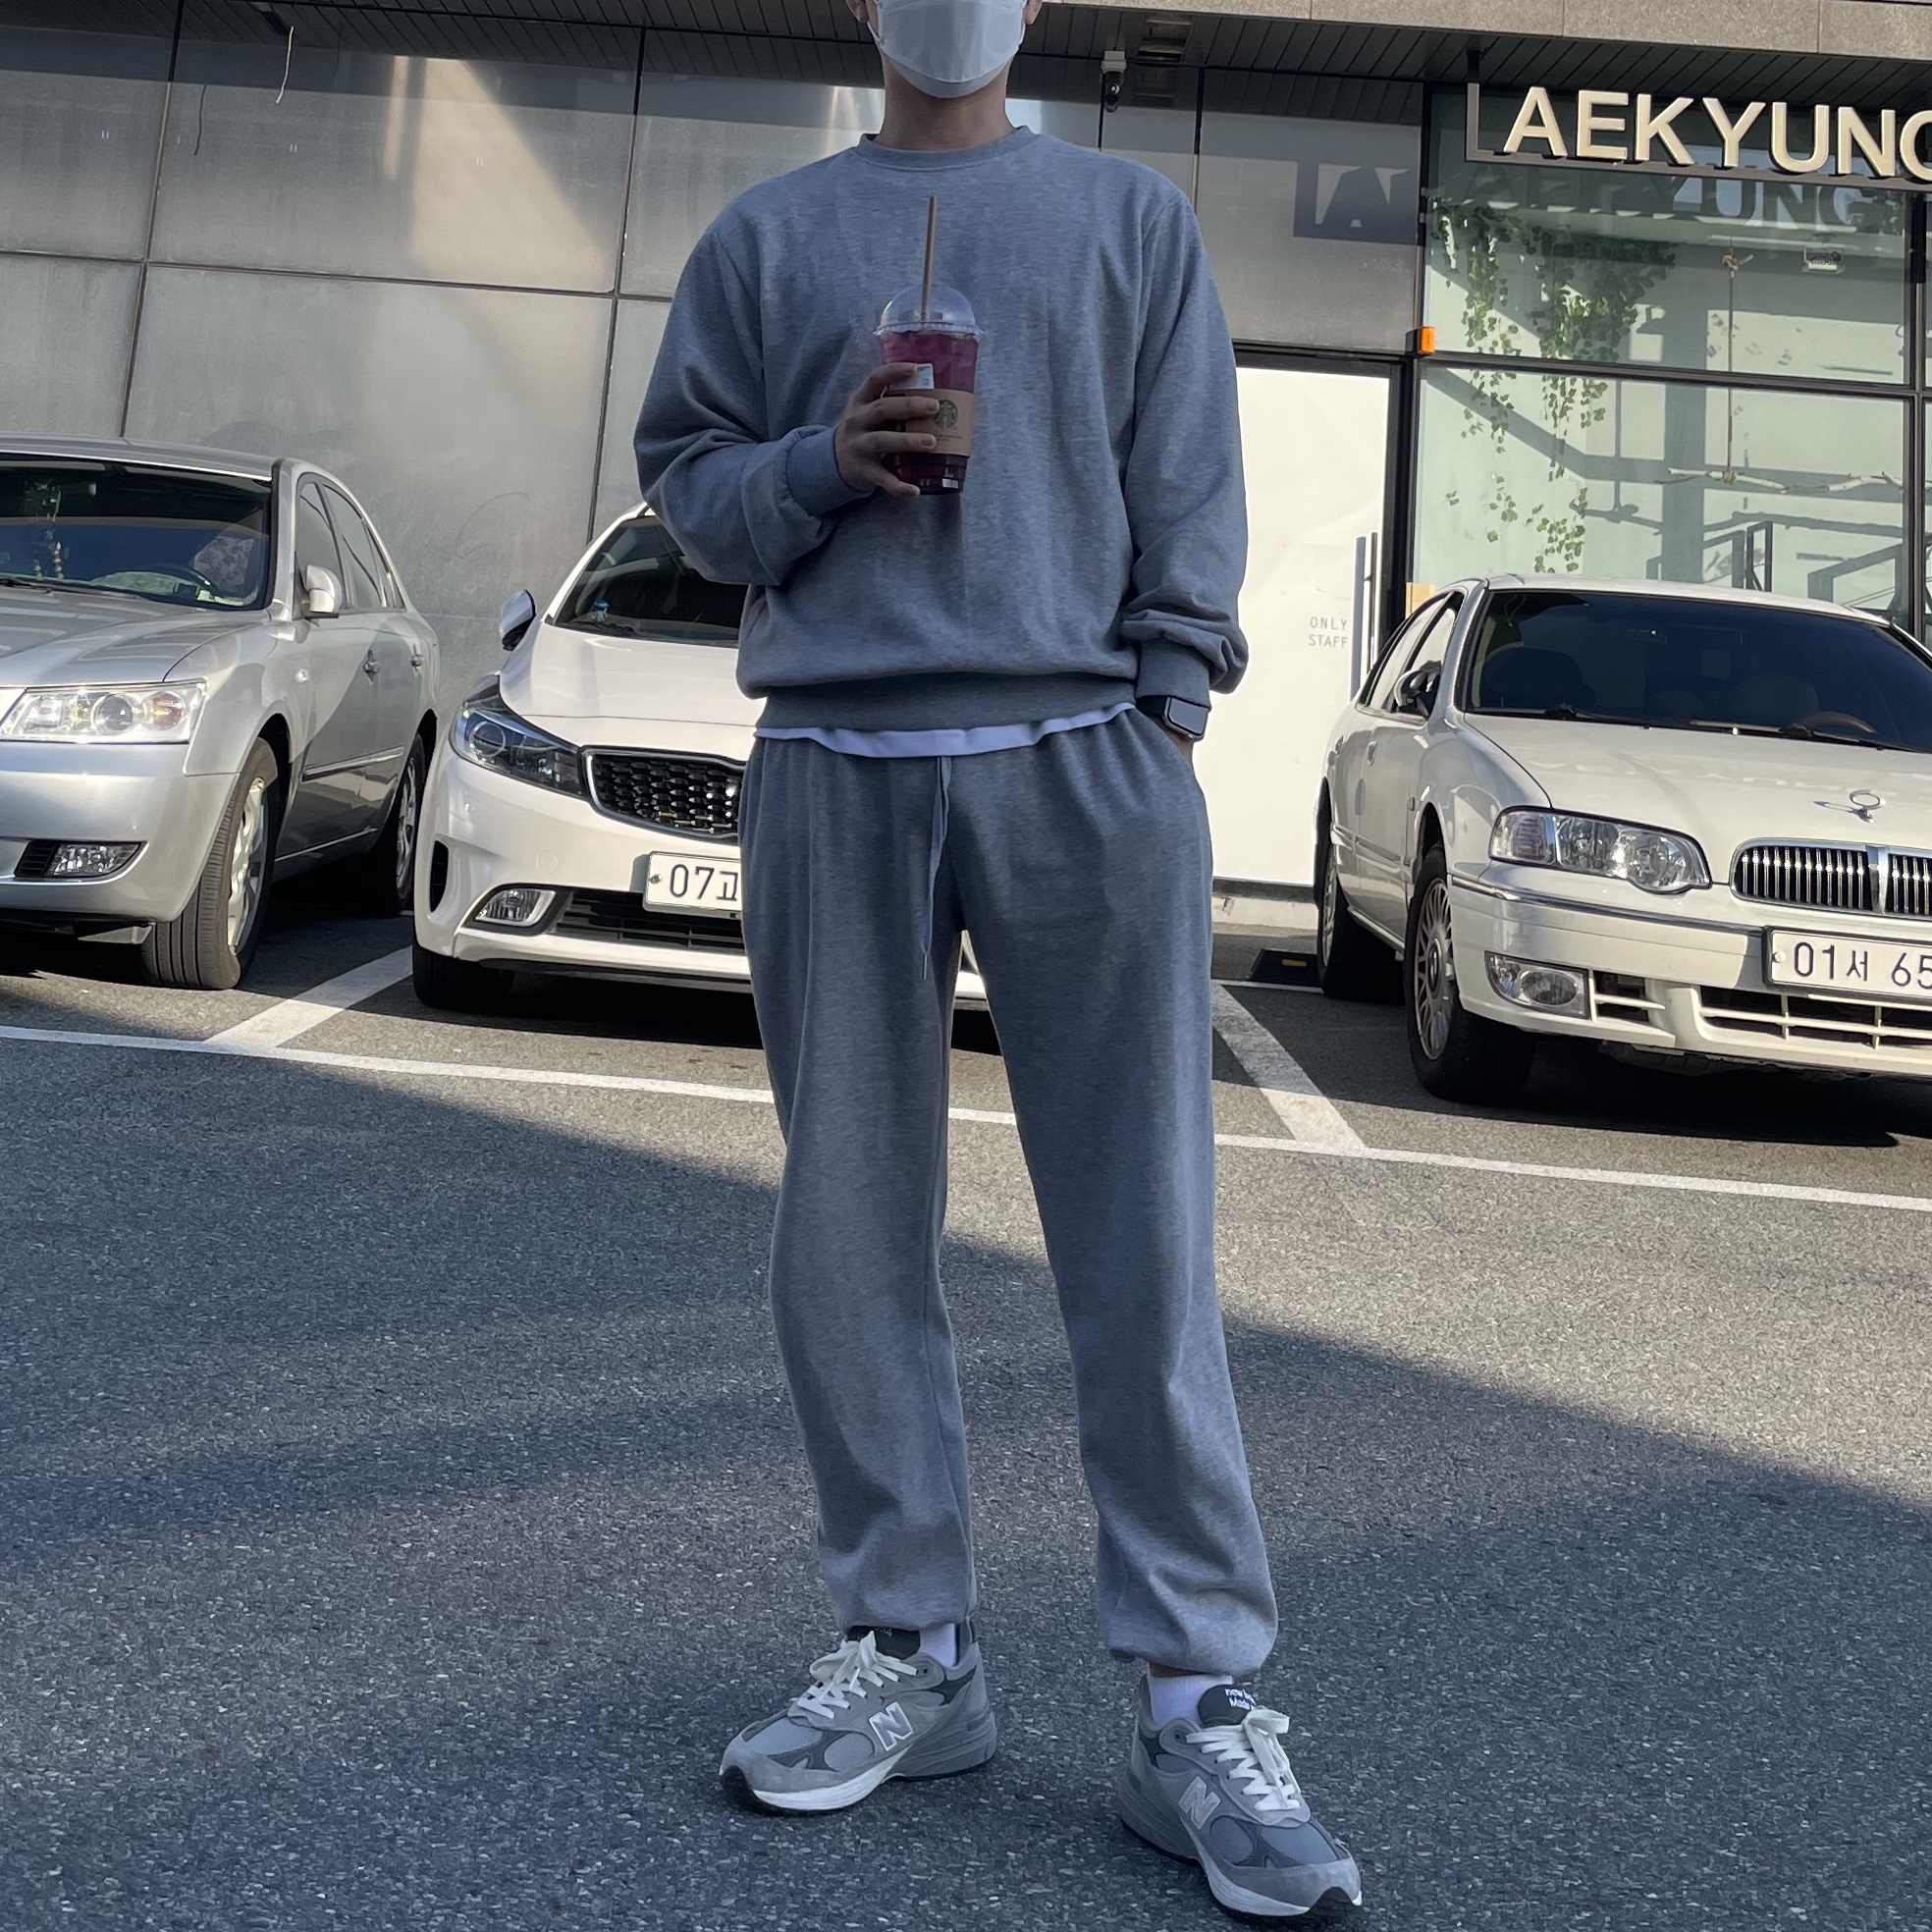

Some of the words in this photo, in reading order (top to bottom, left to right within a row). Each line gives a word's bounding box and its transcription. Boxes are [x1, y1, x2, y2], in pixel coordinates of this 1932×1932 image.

[1308, 633, 1349, 649] STAFF
[1310, 616, 1348, 630] ONLY
[670, 863, 739, 902] 07고
[1794, 941, 1868, 982] 01서
[1891, 952, 1932, 990] 65
[869, 1701, 914, 1751] N
[1178, 1776, 1221, 1831] N
